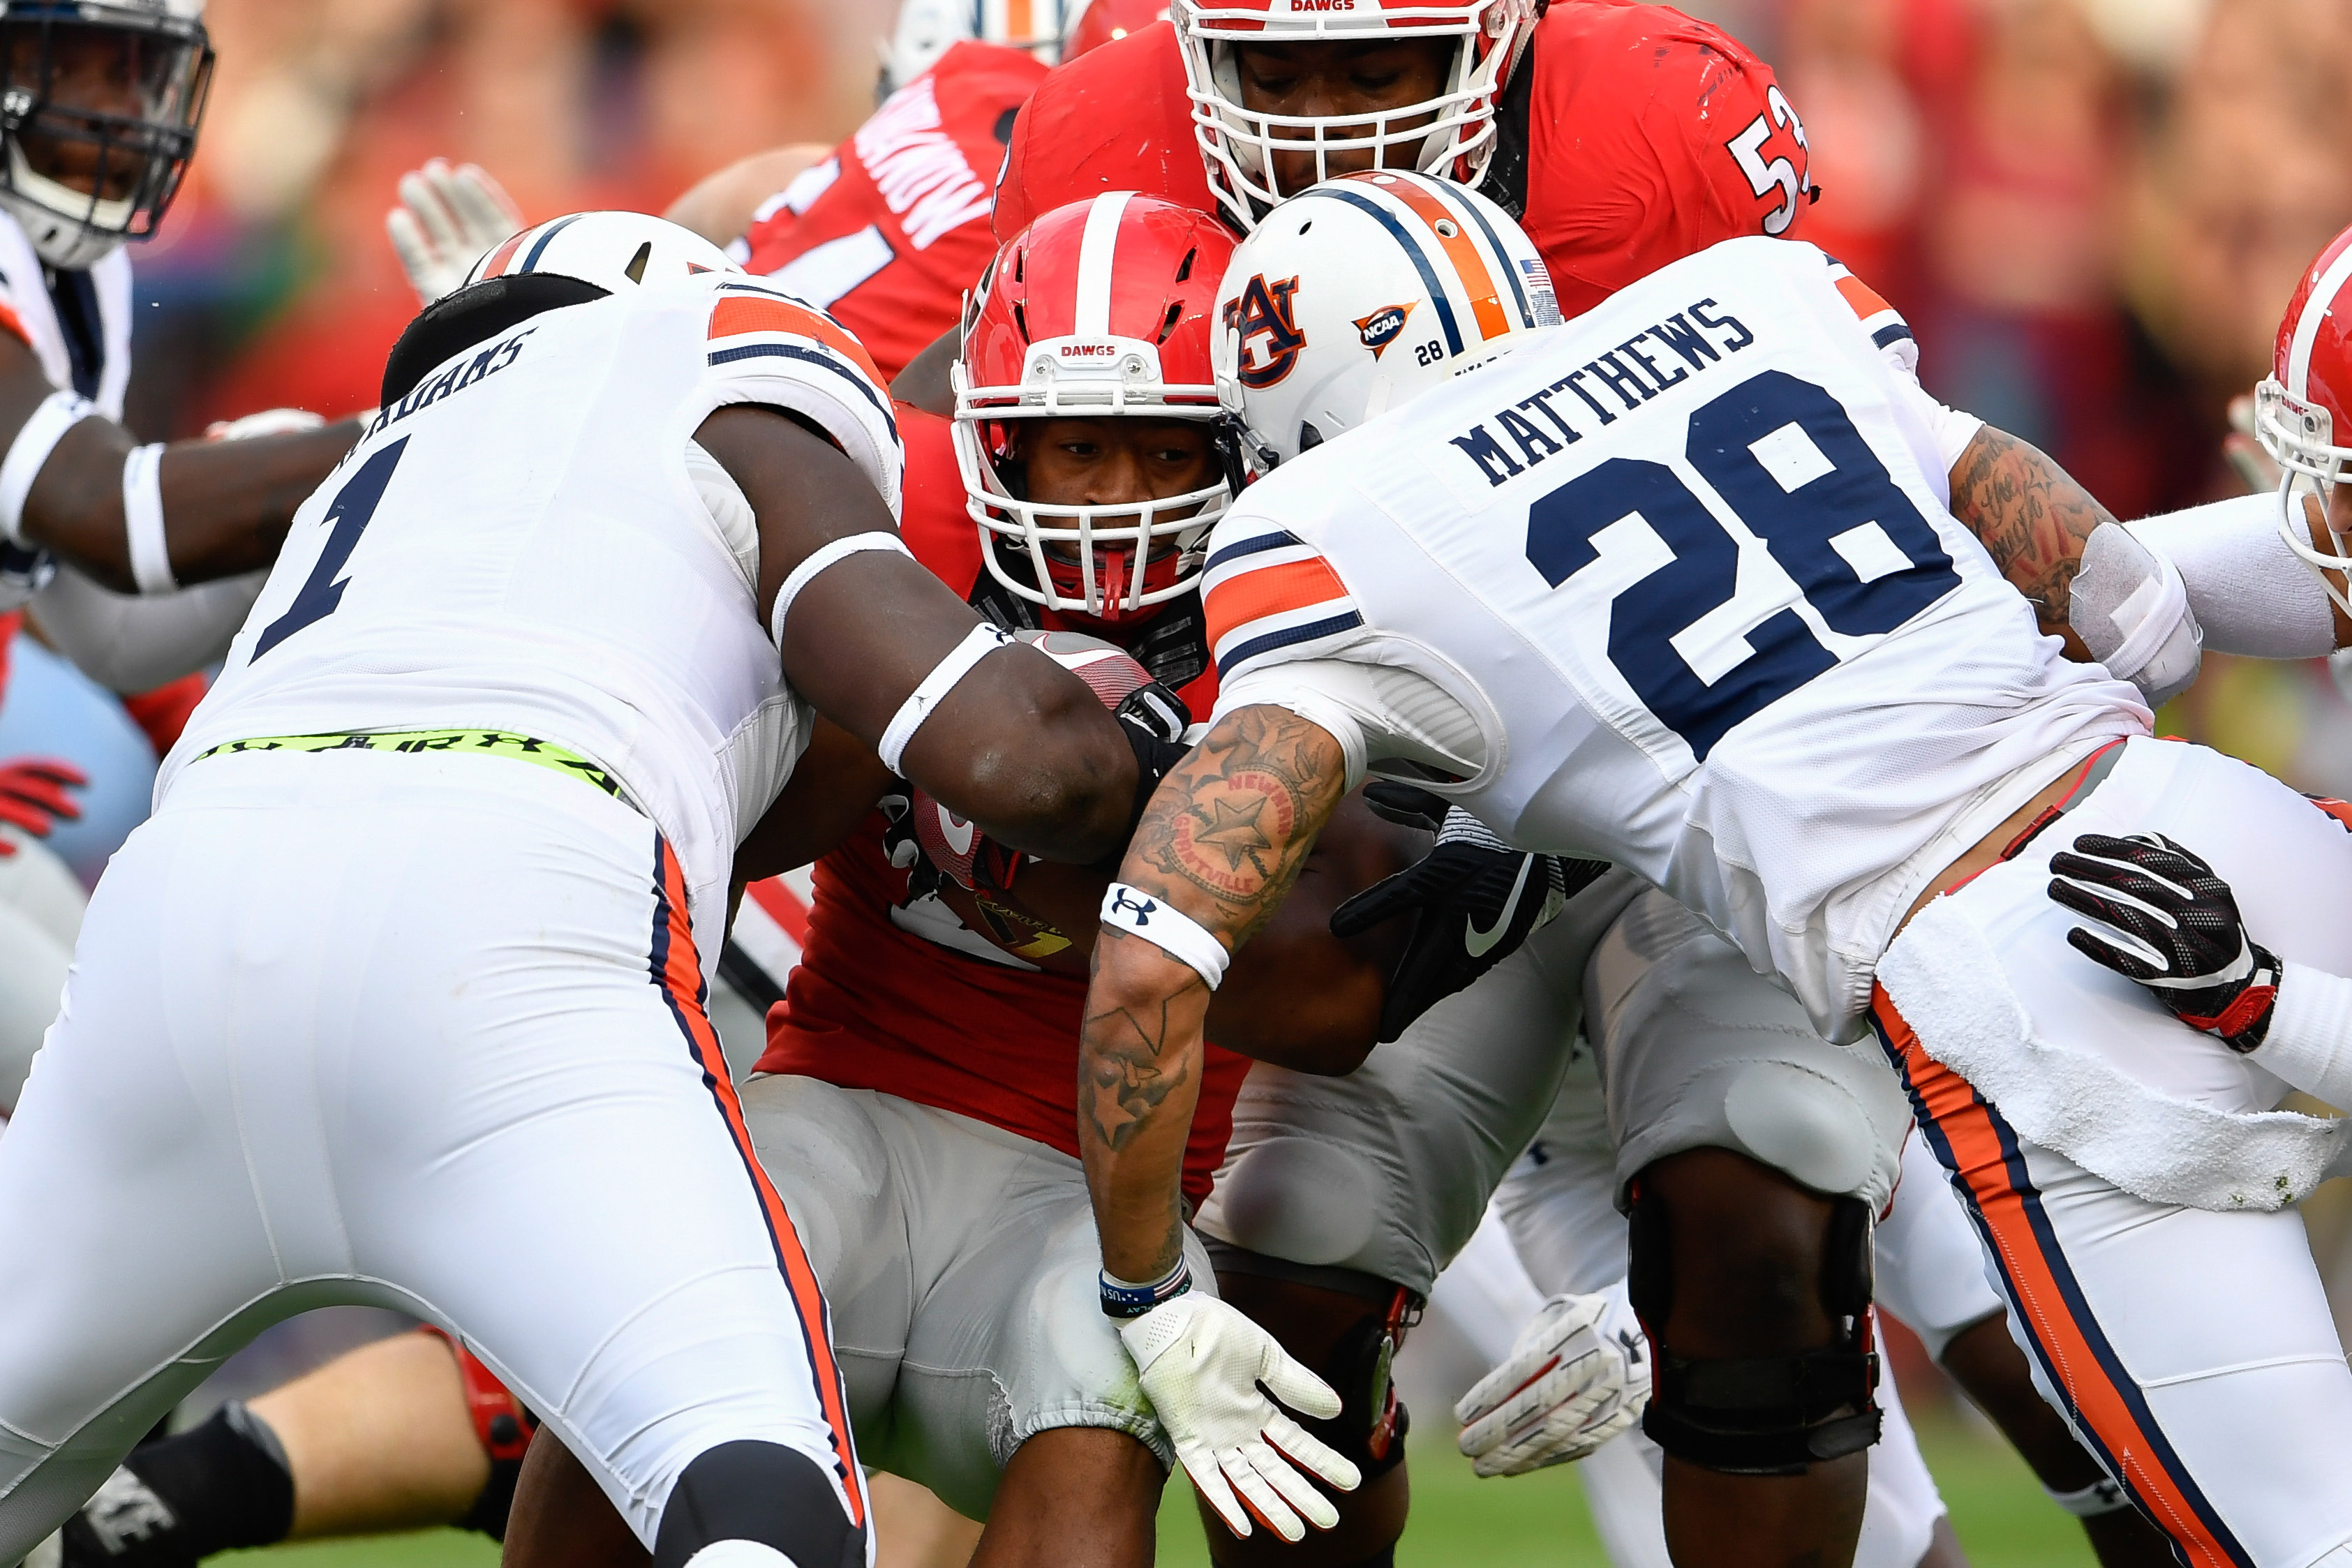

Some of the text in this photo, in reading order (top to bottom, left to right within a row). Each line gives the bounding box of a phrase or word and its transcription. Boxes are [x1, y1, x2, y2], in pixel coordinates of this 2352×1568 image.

[1290, 0, 1355, 11] DAWGS
[1061, 345, 1115, 357] DAWGS
[1363, 315, 1400, 341] NCAA
[1415, 340, 1444, 368] 28
[1448, 297, 1754, 488] MATTHEWS
[246, 433, 412, 668] 1
[1526, 369, 1963, 764] 28
[1173, 816, 1256, 895] GRANTVILLE
